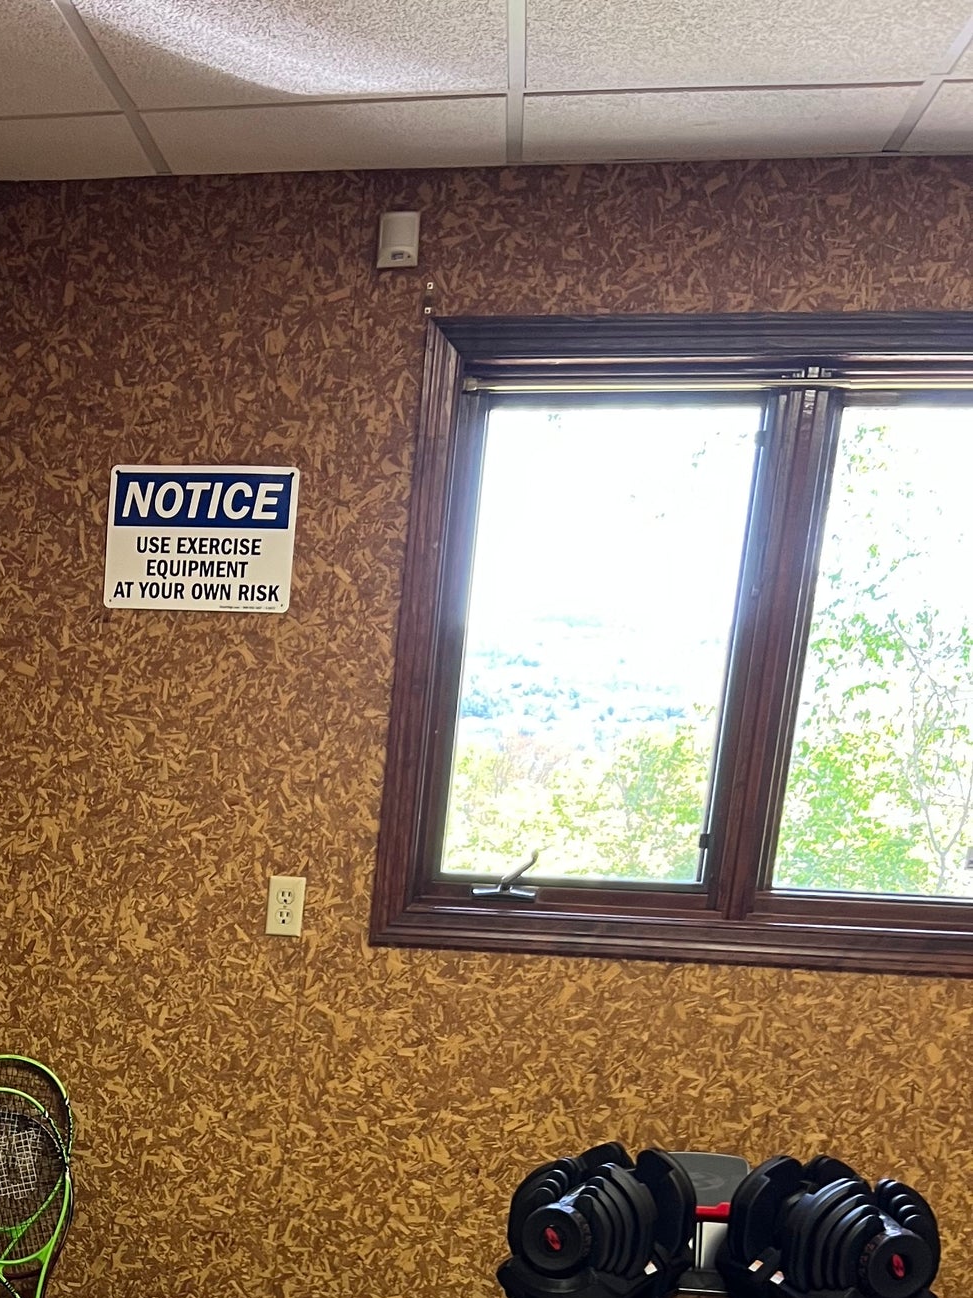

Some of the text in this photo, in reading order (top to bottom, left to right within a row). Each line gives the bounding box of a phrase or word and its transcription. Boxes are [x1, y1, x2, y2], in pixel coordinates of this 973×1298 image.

[122, 481, 284, 520] NOTICE
[137, 536, 262, 555] USE EXERCISE
[146, 559, 249, 579] EQUIPMENT
[113, 581, 280, 602] AT YOUR OWN RISK
